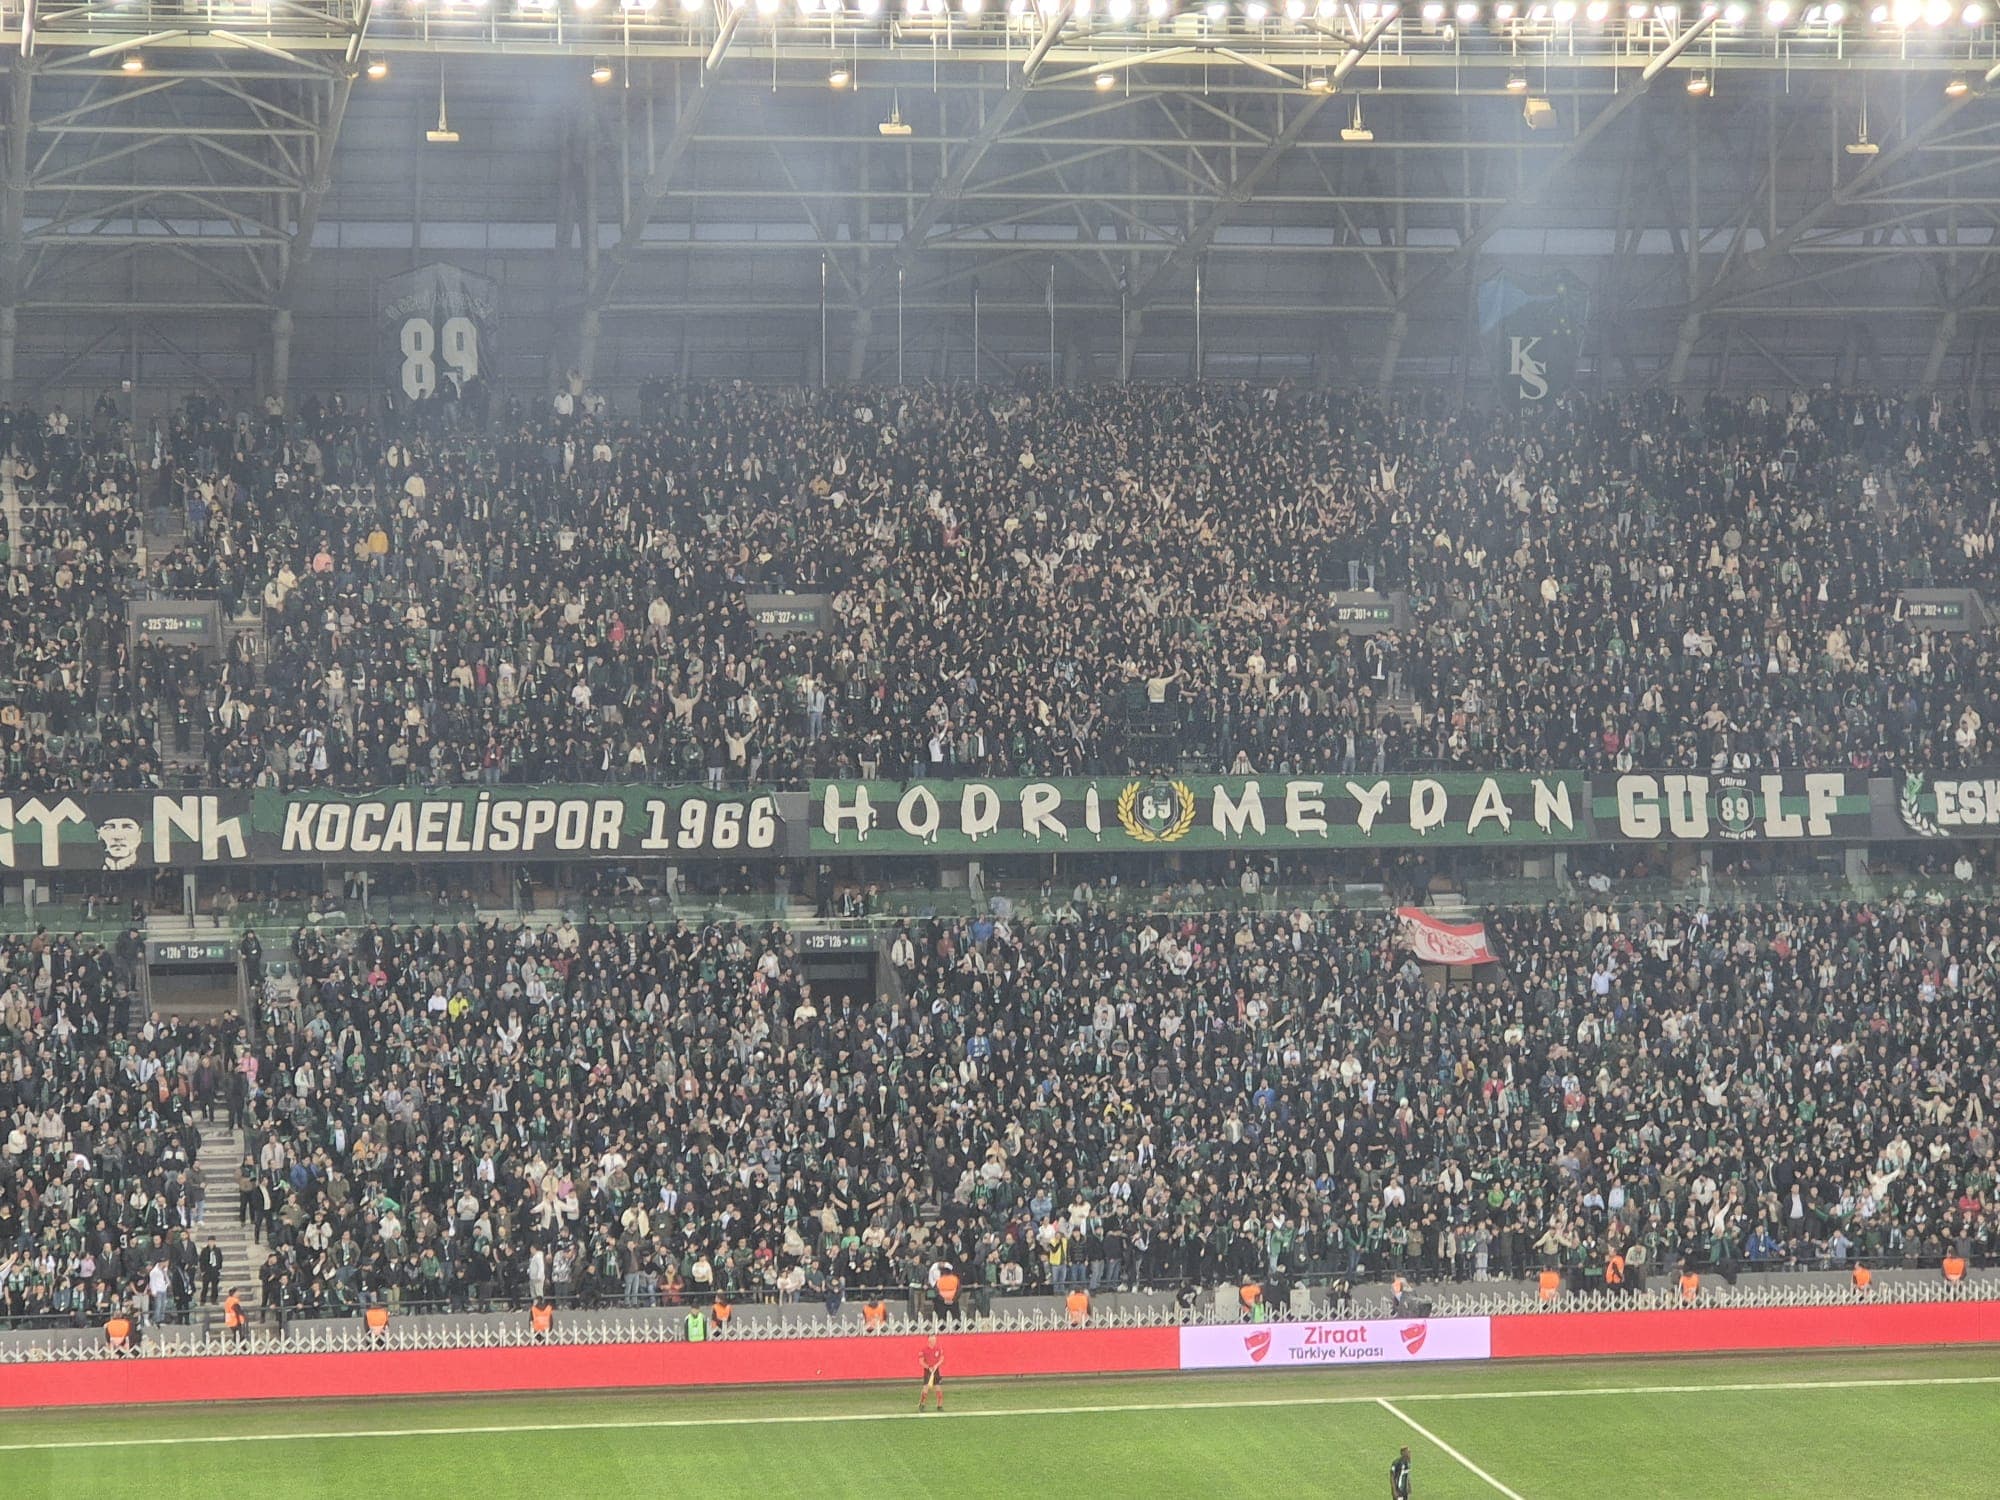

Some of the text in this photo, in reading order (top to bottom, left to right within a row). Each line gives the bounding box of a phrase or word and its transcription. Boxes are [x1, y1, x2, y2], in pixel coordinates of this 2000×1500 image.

[400, 316, 478, 400] 89
[778, 611, 791, 624] 327
[1338, 608, 1366, 620] 327 301
[1212, 777, 1574, 840] MEYDAN
[1721, 797, 1750, 821] 89
[282, 791, 775, 852] KOCAELİSPOR 1966
[812, 935, 825, 949] 125
[1304, 1326, 1367, 1345] Ziraat
[1289, 1346, 1384, 1360] Türkiye Kupası
